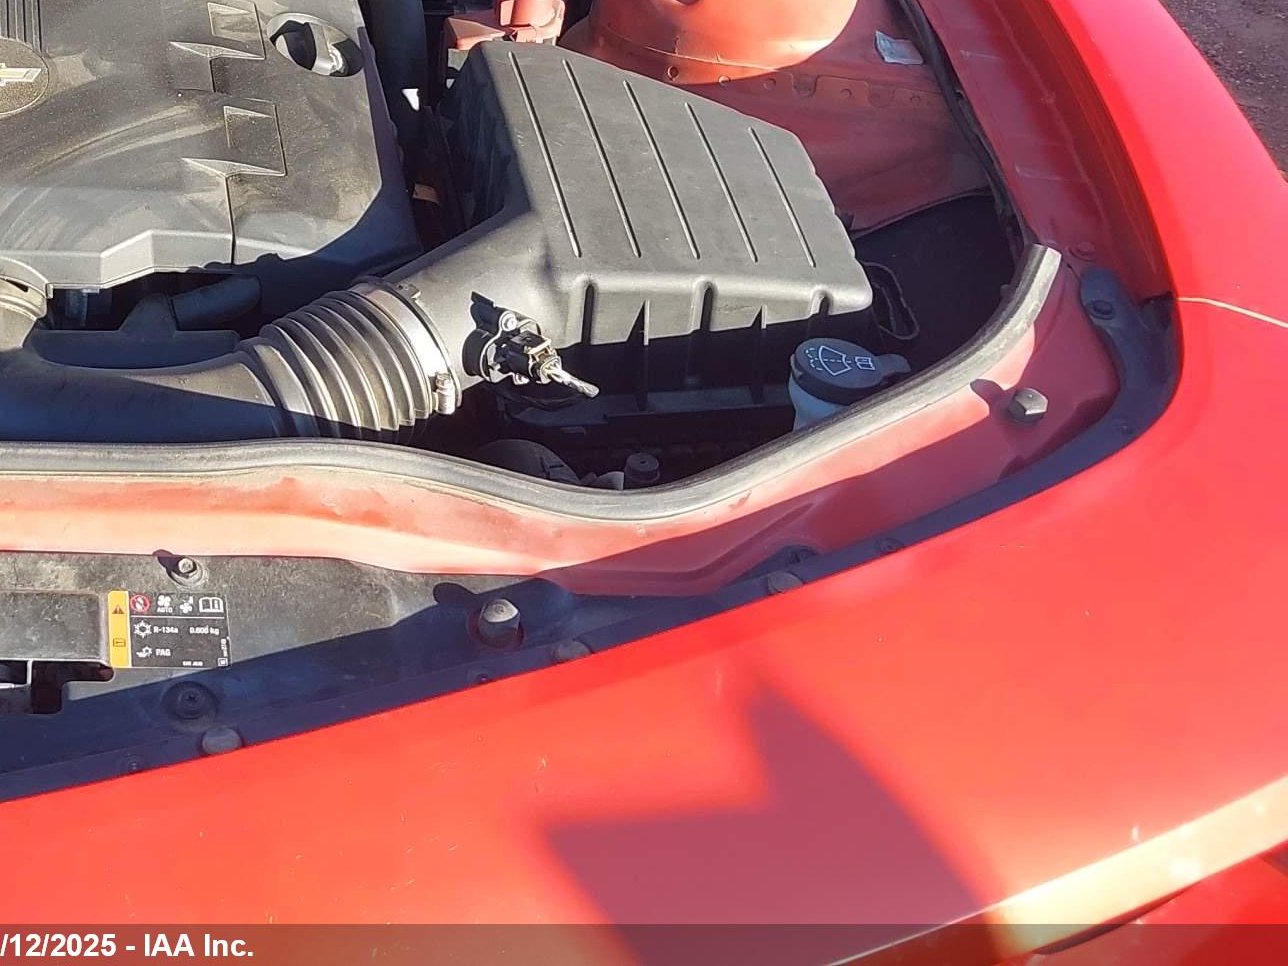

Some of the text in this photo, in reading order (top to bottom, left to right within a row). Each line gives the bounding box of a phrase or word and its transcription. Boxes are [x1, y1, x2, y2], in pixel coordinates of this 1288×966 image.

[156, 606, 173, 614] AUTO
[153, 625, 179, 634] R-134a
[155, 648, 172, 657] PAG
